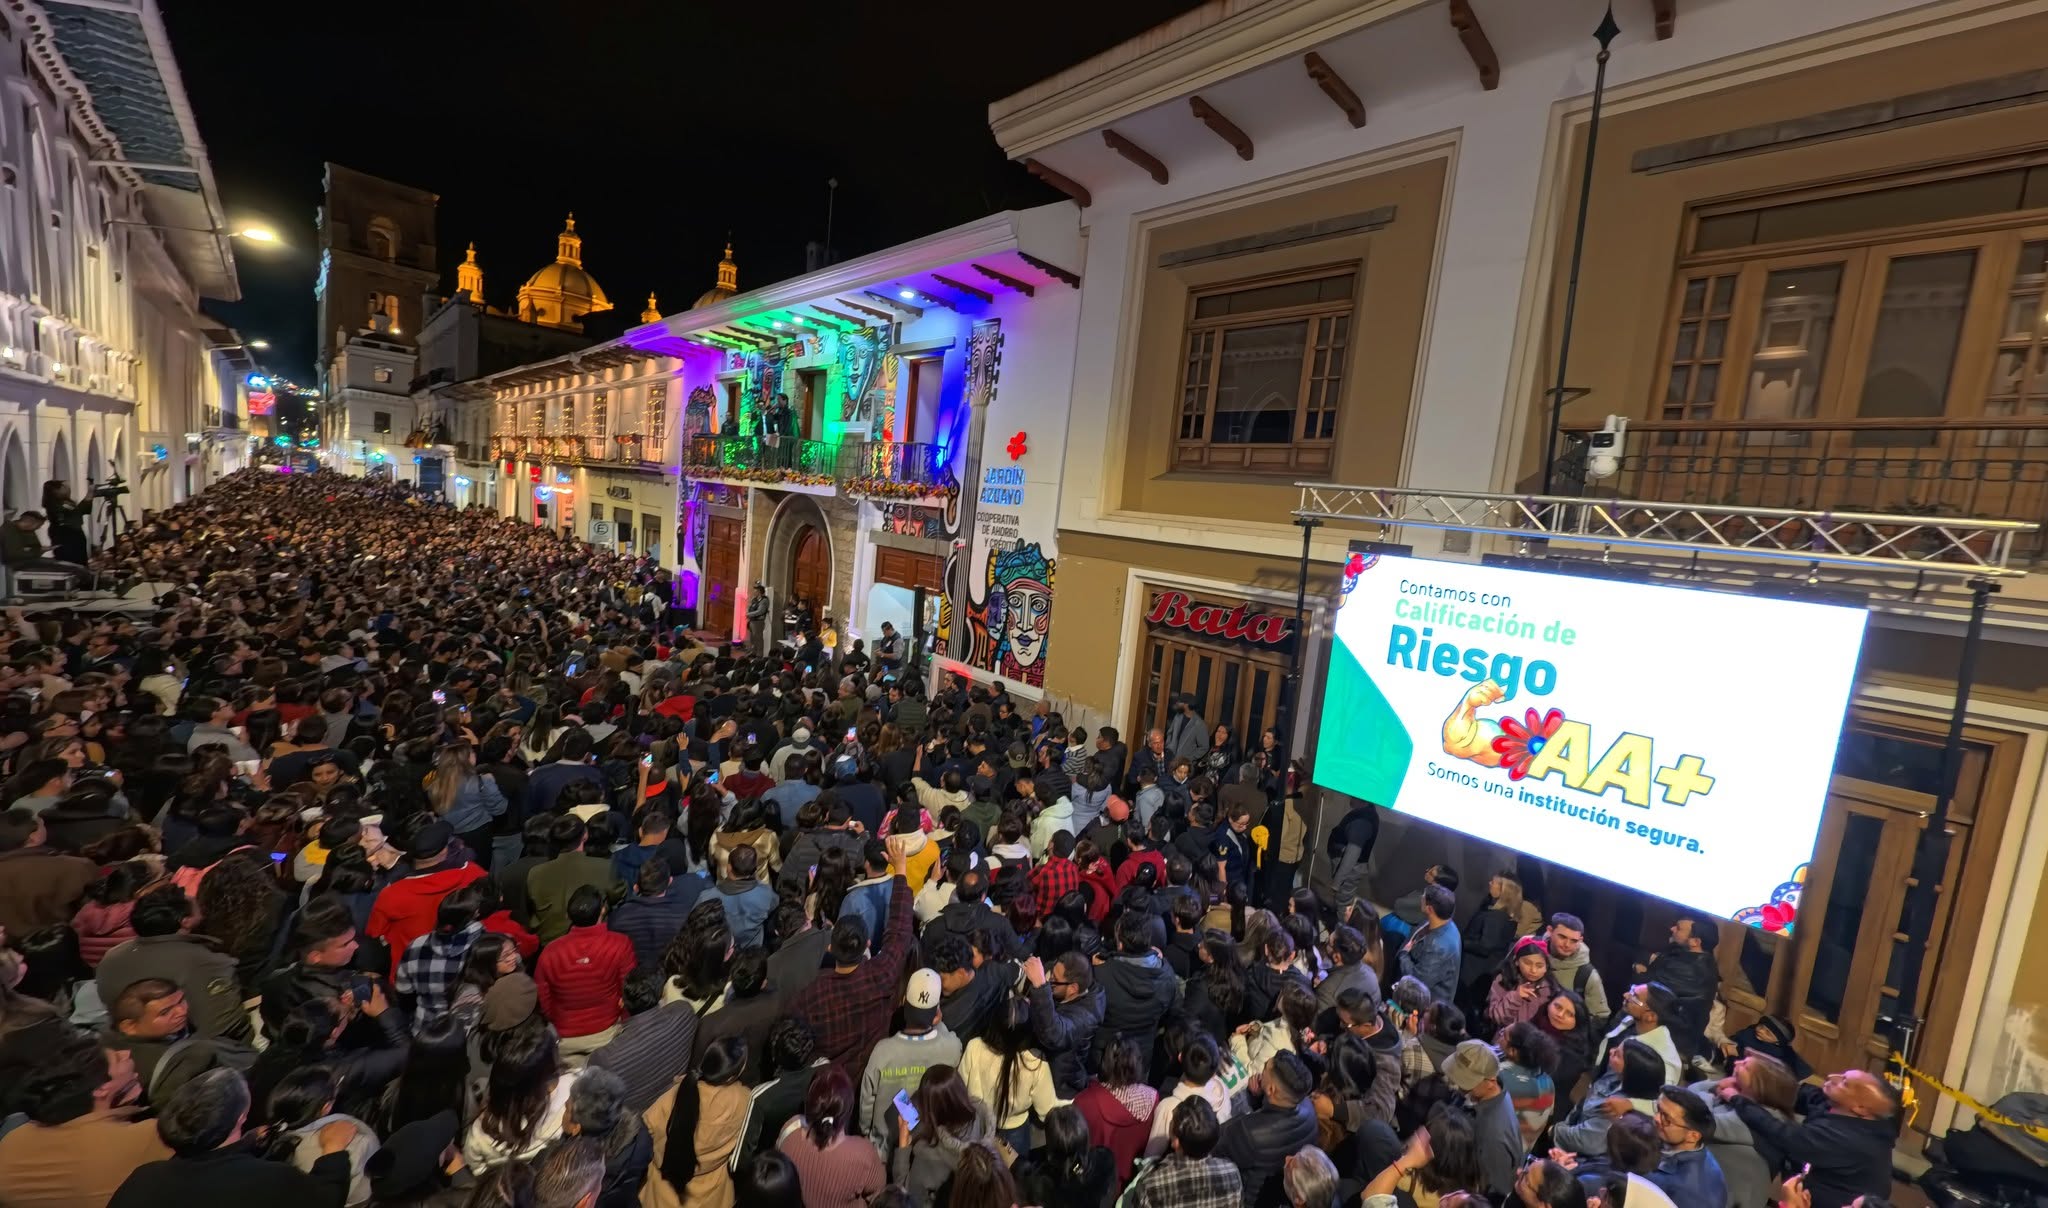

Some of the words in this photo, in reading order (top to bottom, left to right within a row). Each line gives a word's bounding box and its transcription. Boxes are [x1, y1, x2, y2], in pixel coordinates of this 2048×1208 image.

[984, 464, 1025, 485] JARDÍN
[980, 487, 1023, 505] AZUAYO
[976, 511, 1020, 526] COOPERATIVA
[982, 524, 991, 535] DE
[991, 526, 1019, 539] AHORRO
[984, 537, 990, 547] Y
[990, 537, 1016, 551] CRÉDITO
[1400, 579, 1476, 604] Contamos
[1481, 593, 1511, 608] con
[1147, 591, 1293, 643] Bata
[1395, 598, 1536, 640] Calificación
[1543, 620, 1577, 646] de
[1387, 624, 1557, 704] Riesgo
[1527, 719, 1716, 809] AA+
[1427, 761, 1479, 789] Somos
[1484, 781, 1514, 799] una
[1518, 787, 1620, 830] institución
[1625, 819, 1705, 855] segura.
